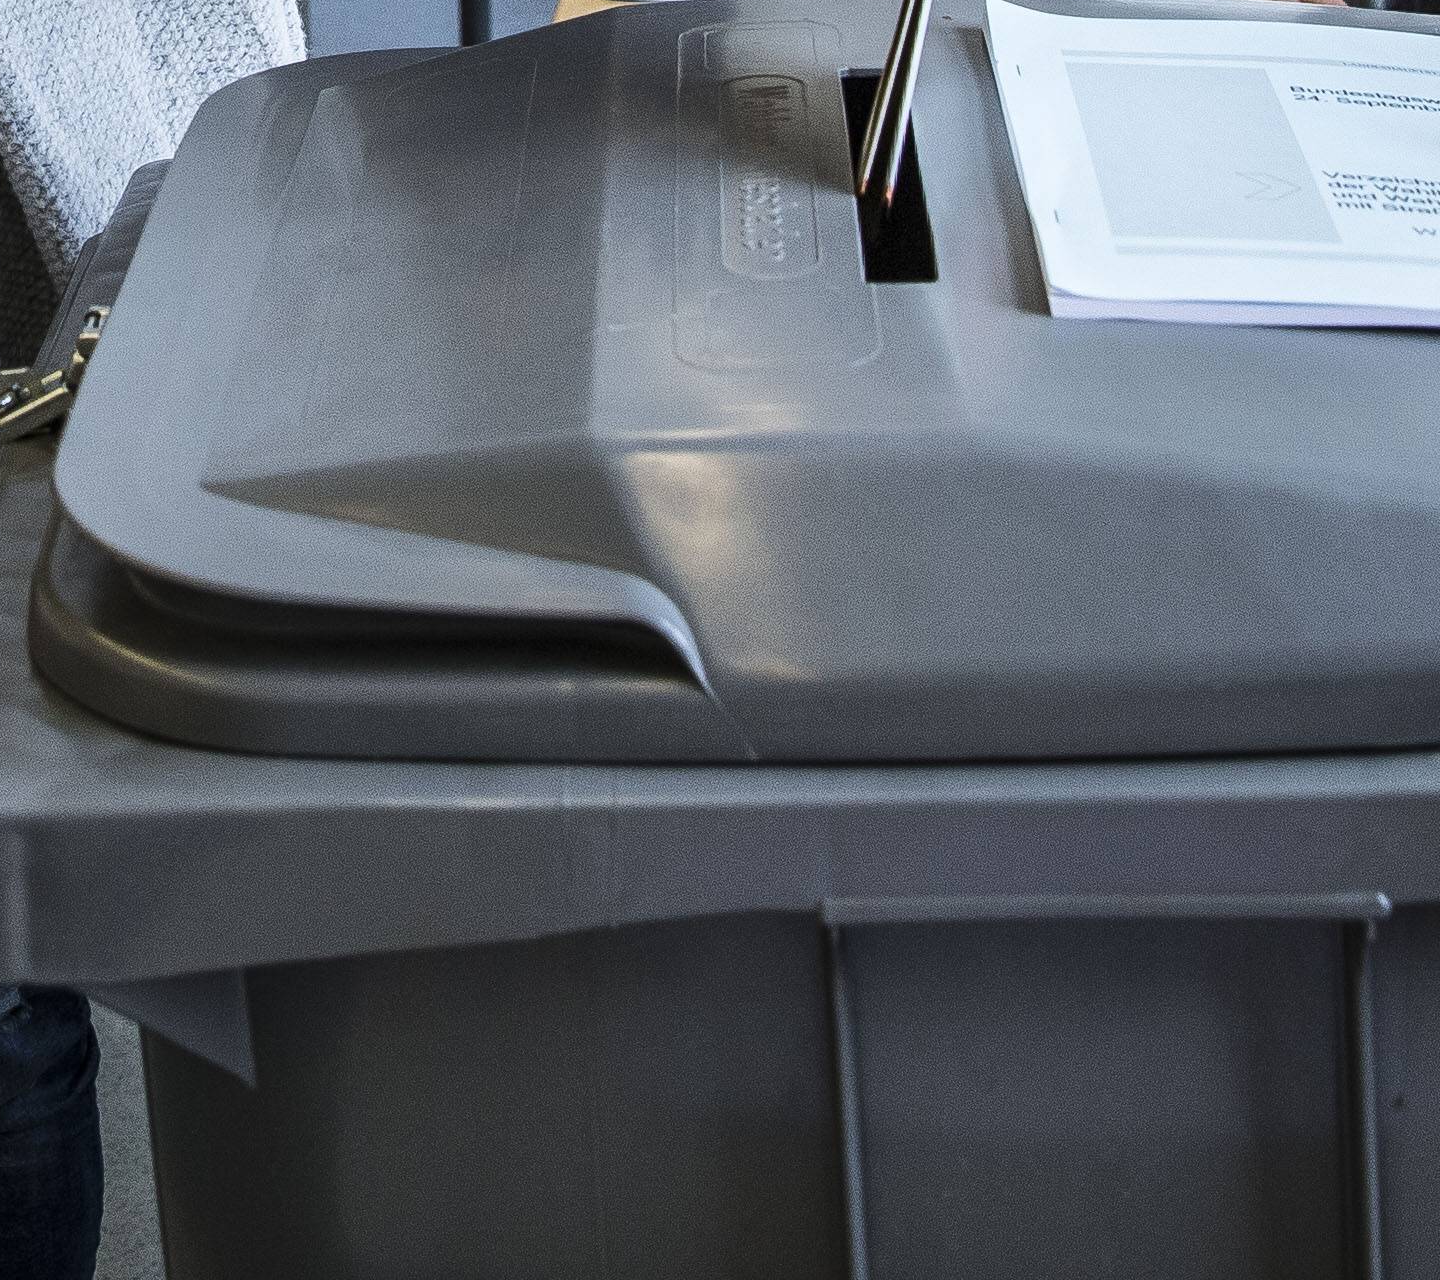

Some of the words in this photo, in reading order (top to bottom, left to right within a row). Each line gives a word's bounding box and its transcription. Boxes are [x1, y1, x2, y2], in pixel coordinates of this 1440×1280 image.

[1293, 93, 1329, 102] 24.
[1327, 180, 1364, 189] der
[1331, 191, 1378, 200] und
[1336, 200, 1373, 209] mit
